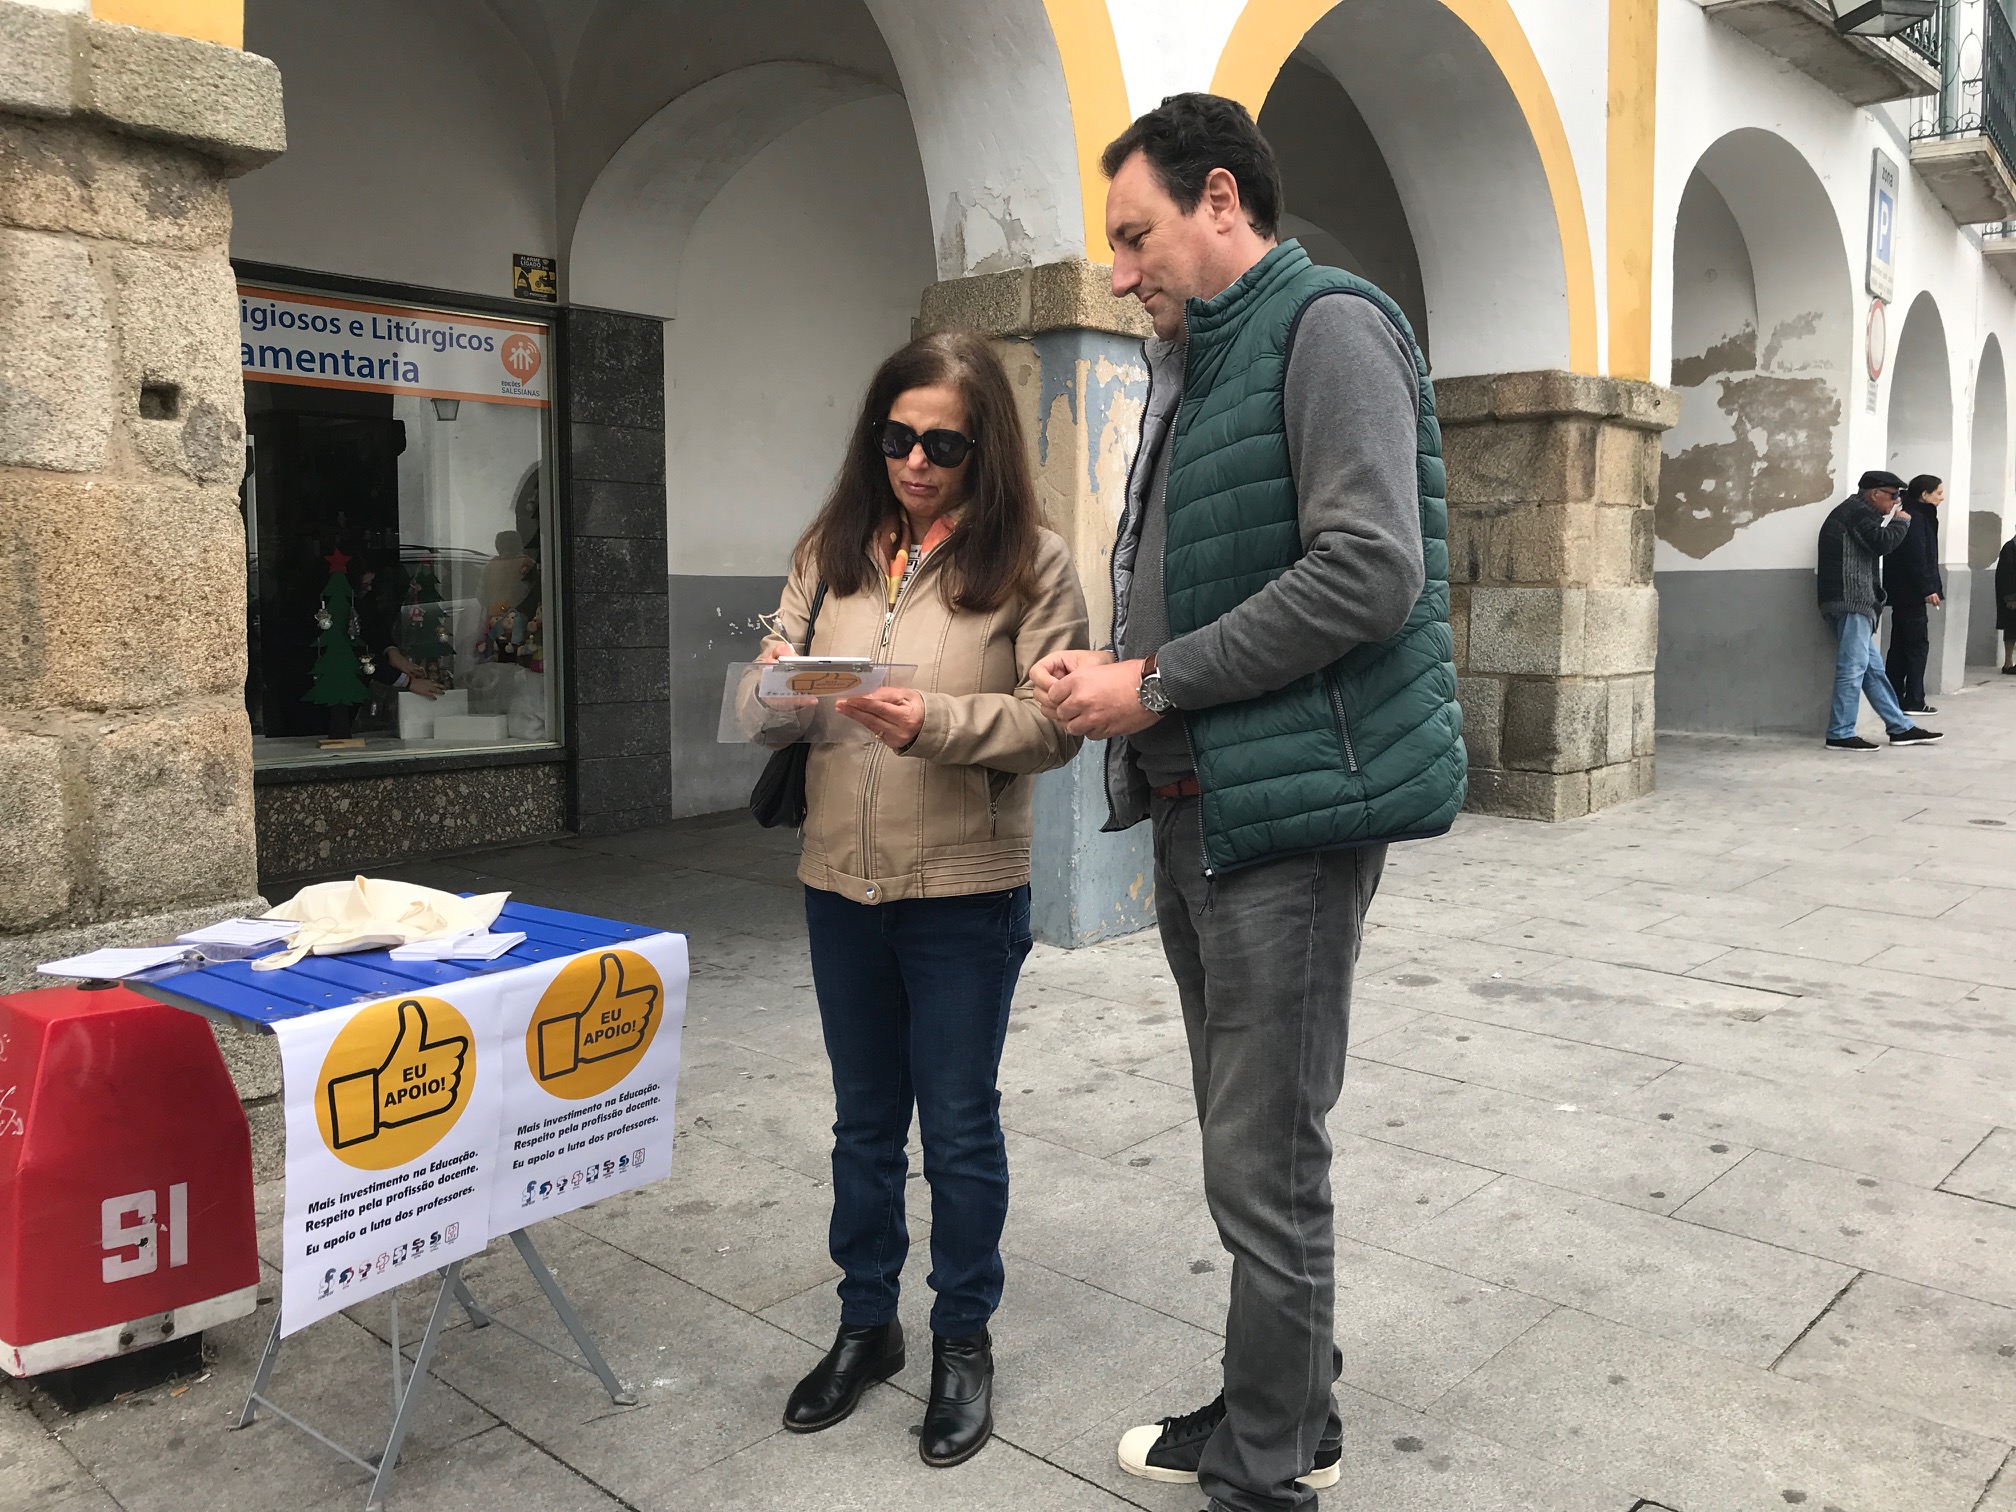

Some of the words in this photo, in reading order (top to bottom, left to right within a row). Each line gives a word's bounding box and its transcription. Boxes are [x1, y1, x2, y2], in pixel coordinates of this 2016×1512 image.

[1882, 166, 1893, 188] zona
[1880, 200, 1889, 251] P
[349, 320, 364, 337] e
[372, 317, 494, 352] Litúrgicos
[241, 342, 419, 383] amentaria
[501, 380, 520, 388] EDIÇÕES
[501, 387, 540, 397] SALESIANAS
[583, 1020, 636, 1046] APOIO!
[601, 1008, 621, 1025] EU
[384, 1076, 445, 1108] APOIO!
[402, 1063, 426, 1083] EU
[514, 1132, 555, 1150] Respeito
[558, 1124, 579, 1138] pela
[581, 1109, 622, 1130] profissão
[626, 1096, 660, 1113] docente.
[517, 1122, 540, 1136] Mais
[543, 1103, 602, 1127] investimento
[605, 1098, 616, 1107] na
[619, 1083, 660, 1102] Educação.
[512, 1160, 524, 1169] Eu
[527, 1150, 555, 1165] apoio
[558, 1147, 564, 1155] a
[567, 1140, 585, 1152] luta
[588, 1134, 604, 1145] dos
[607, 1116, 658, 1140] professores.
[305, 1209, 355, 1233] Respeito
[359, 1198, 382, 1216] pela
[386, 1180, 434, 1206] profissão
[438, 1165, 479, 1185] docente.
[308, 1198, 335, 1214] Mais
[340, 1174, 409, 1203] investimento
[413, 1168, 426, 1178] na
[430, 1150, 478, 1173] Educação.
[306, 1244, 319, 1256] Eu
[323, 1231, 355, 1249] apoio
[360, 1227, 367, 1236] a
[371, 1217, 391, 1231] luta
[395, 1209, 413, 1222] dos
[416, 1186, 475, 1216] professores.
